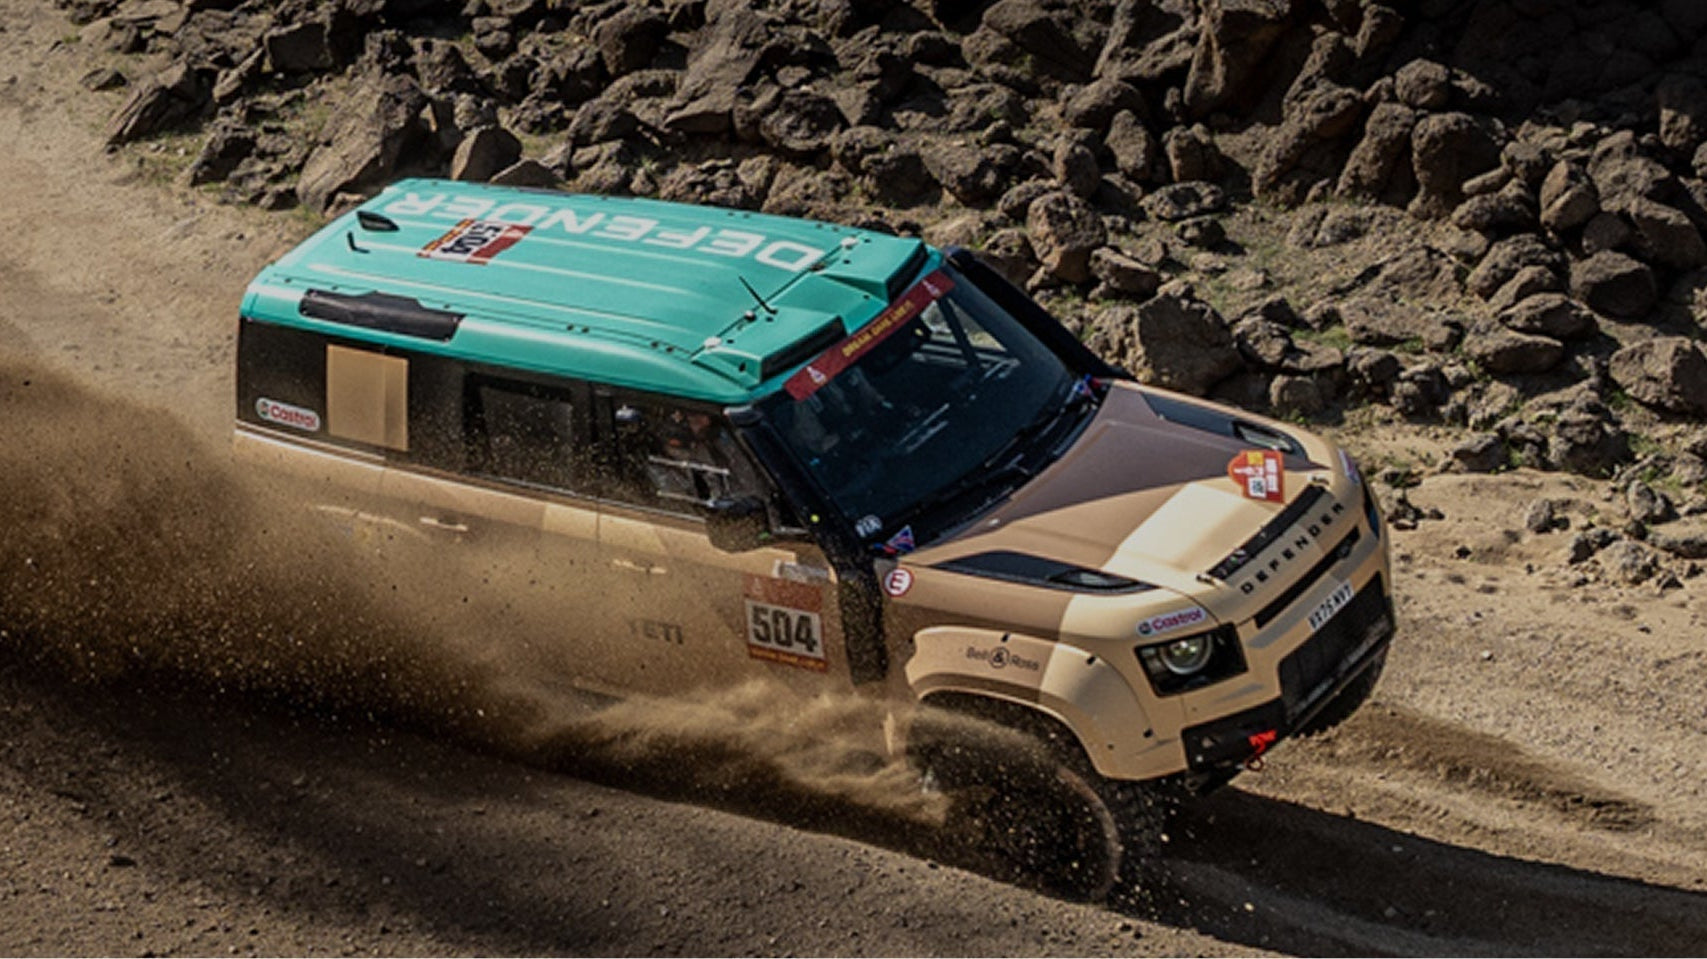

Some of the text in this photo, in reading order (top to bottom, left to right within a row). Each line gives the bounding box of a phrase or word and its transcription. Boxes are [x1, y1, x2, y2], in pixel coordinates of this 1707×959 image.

[384, 192, 826, 272] DEFENDER
[440, 222, 503, 255] 504
[270, 404, 317, 428] Castrol
[1240, 502, 1345, 595] DEFENDER
[752, 604, 819, 653] 504
[1152, 607, 1203, 631] Castrol
